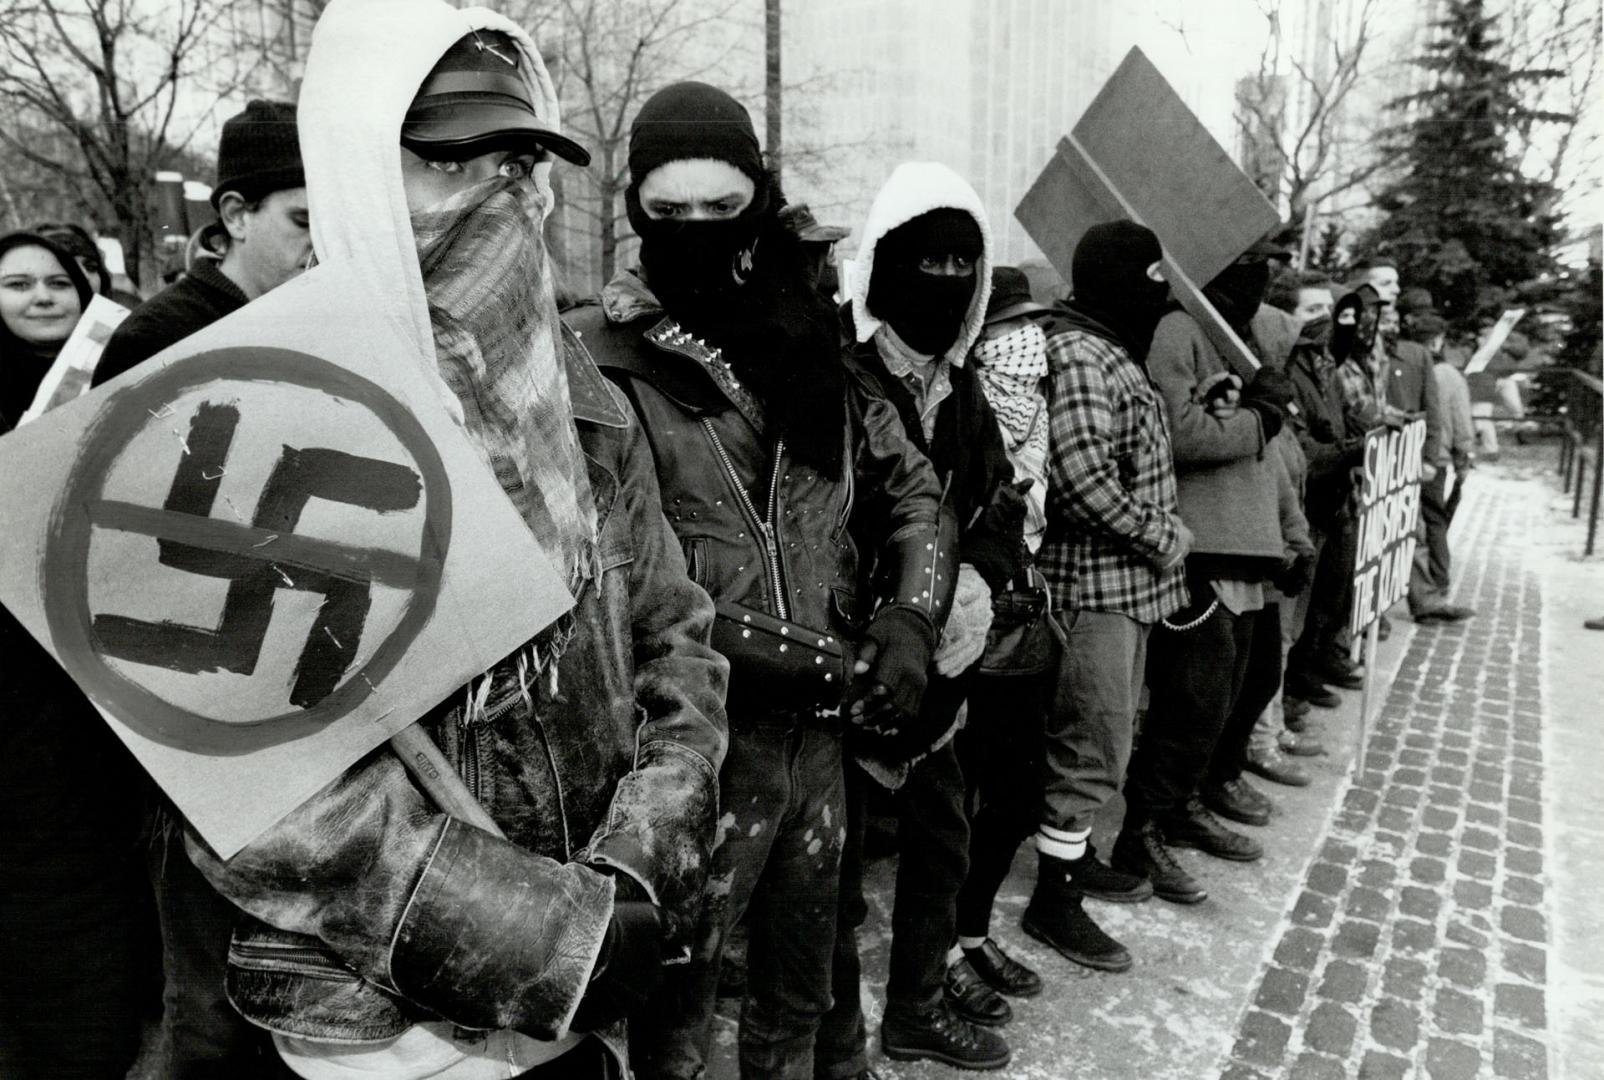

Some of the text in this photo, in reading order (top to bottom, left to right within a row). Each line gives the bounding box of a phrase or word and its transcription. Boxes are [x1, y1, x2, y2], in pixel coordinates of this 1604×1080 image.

[1362, 419, 1427, 506] SAVE OUR
[1352, 565, 1379, 635] THE
